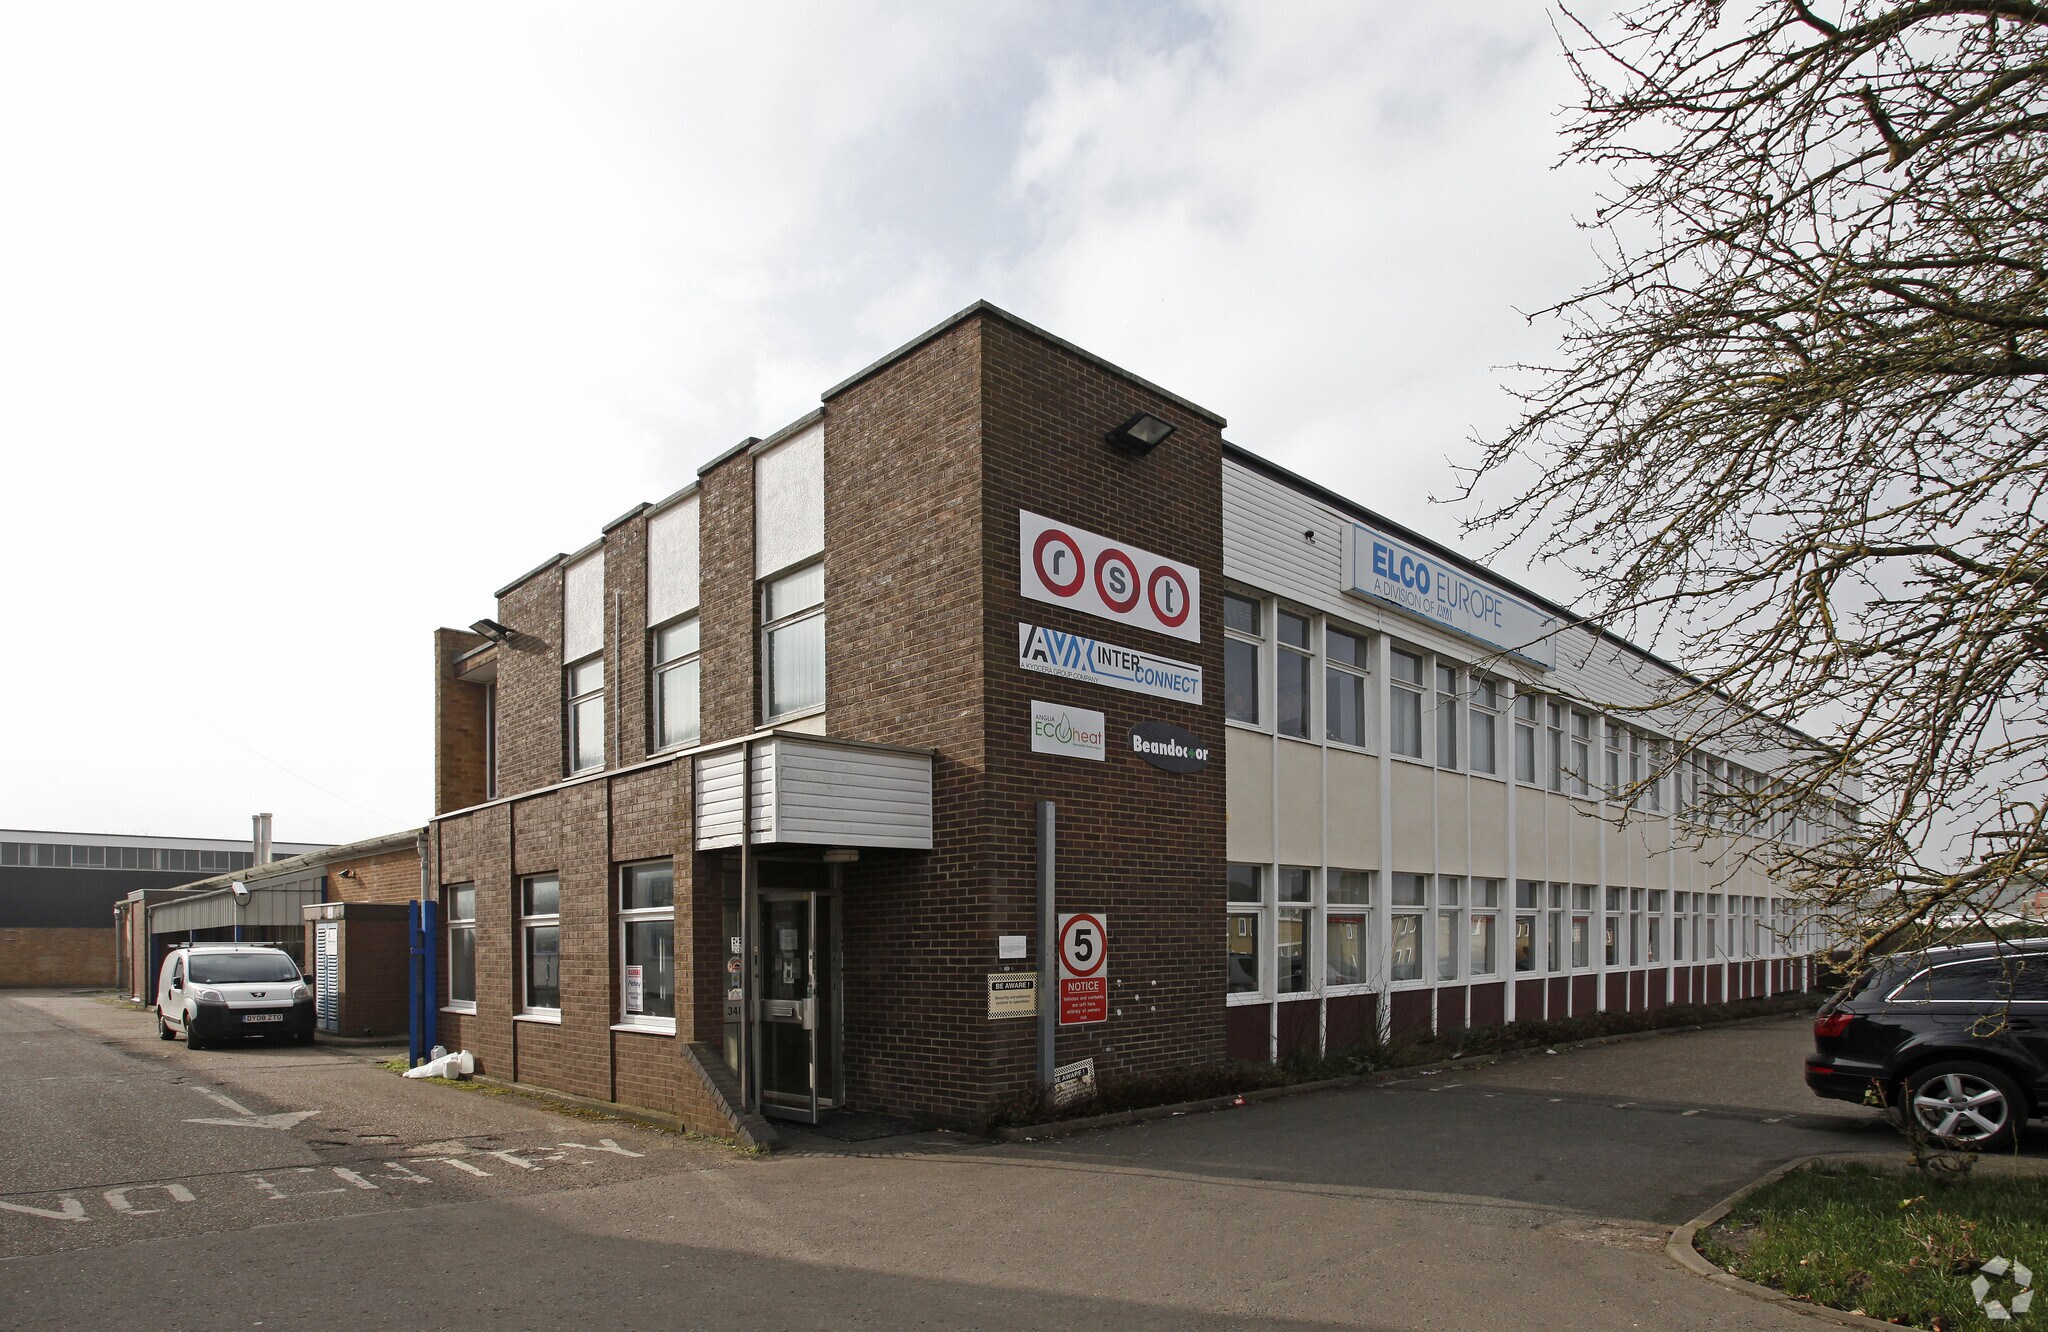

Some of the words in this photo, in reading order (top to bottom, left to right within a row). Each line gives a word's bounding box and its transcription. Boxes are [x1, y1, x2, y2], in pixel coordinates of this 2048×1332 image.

[1373, 541, 1430, 594] ELCO
[1437, 571, 1503, 628] EUROPE
[1374, 578, 1381, 593] A
[1384, 581, 1421, 609] DIVISION
[1423, 599, 1434, 613] OF
[1022, 625, 1097, 674] AVX
[1053, 668, 1074, 678] GROUP
[1074, 672, 1099, 683] COMPANY
[1134, 666, 1199, 695] CONNECT
[1035, 714, 1056, 722] ANGLIA
[1075, 929, 1093, 962] 5
[1068, 981, 1099, 991] NOTICE
